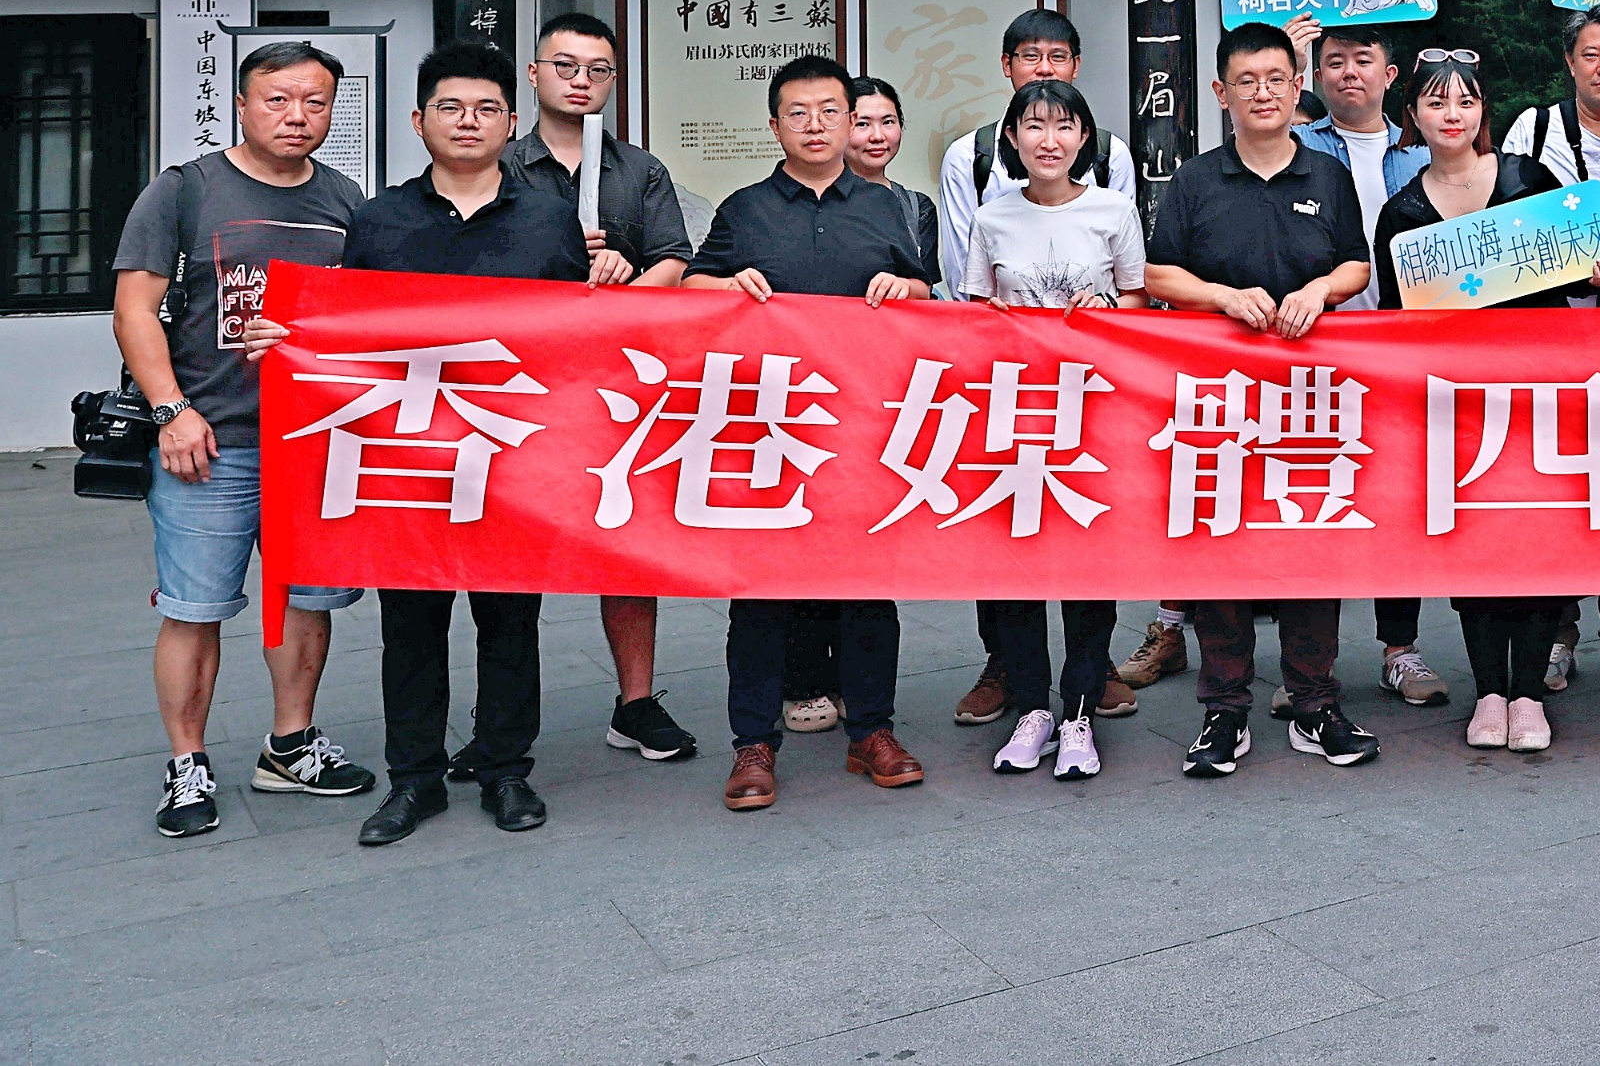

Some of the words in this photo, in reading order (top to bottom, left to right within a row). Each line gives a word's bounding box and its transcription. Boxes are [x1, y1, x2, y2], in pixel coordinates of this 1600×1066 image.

[685, 41, 832, 62] 眉山苏氏的家国情怀
[194, 30, 221, 161] 中国东坡文
[175, 251, 187, 283] SONY
[1396, 218, 1503, 288] 相約山海
